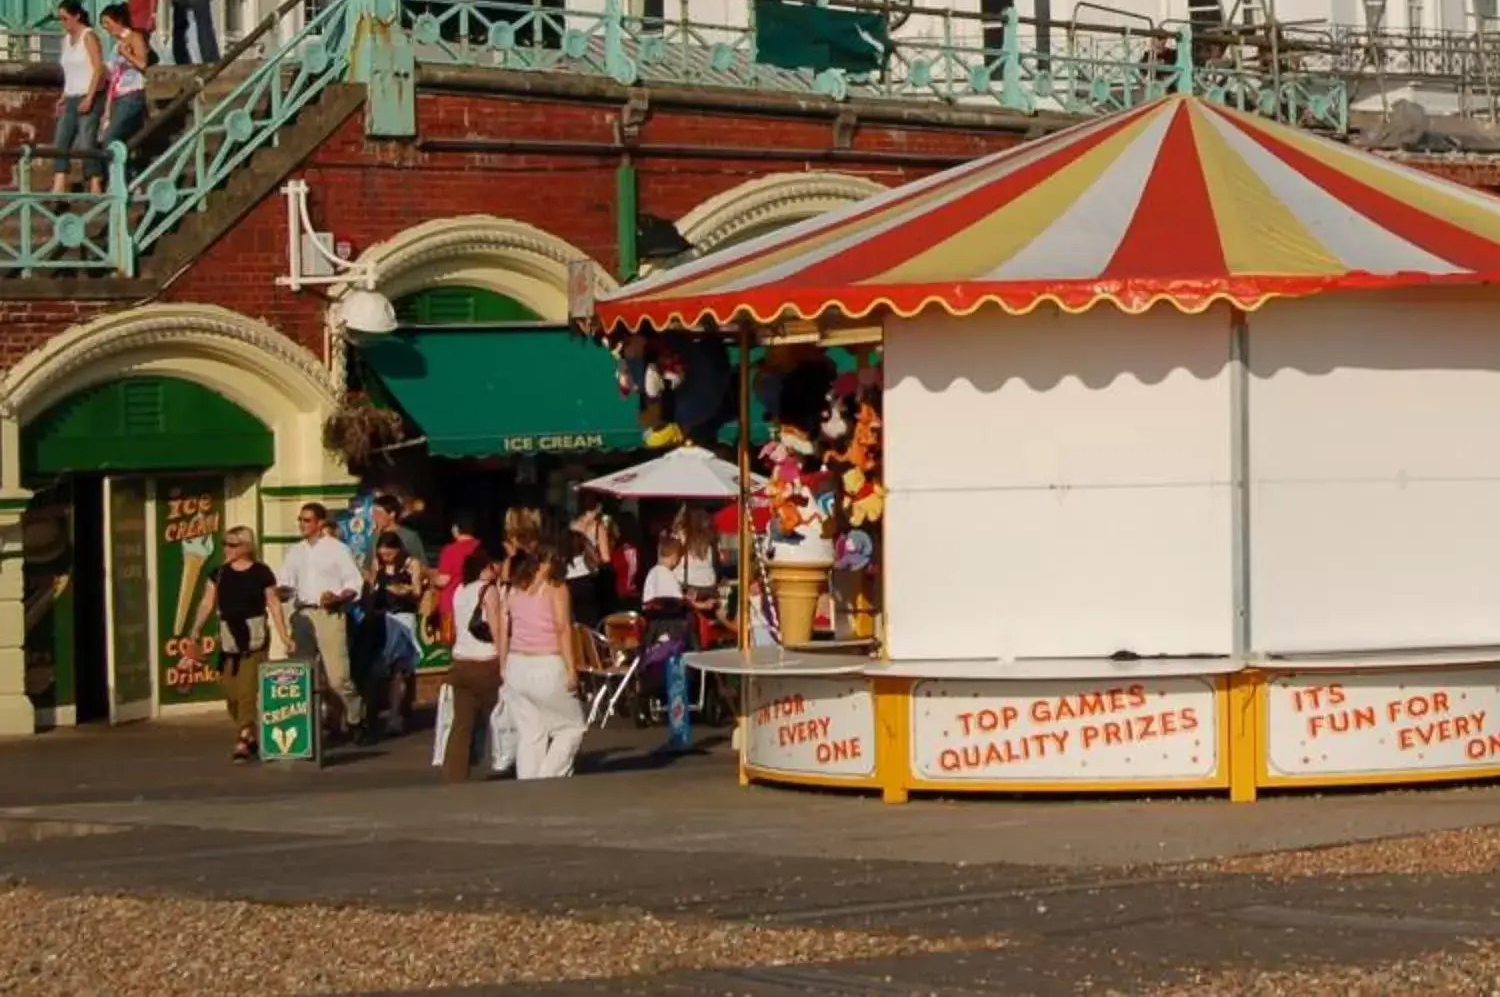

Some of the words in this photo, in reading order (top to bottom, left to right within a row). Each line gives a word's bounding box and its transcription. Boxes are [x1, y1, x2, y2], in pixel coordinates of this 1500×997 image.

[503, 436, 533, 452] ICE
[540, 434, 603, 450] CREAM
[164, 511, 220, 542] CREAM
[165, 636, 215, 656] COD
[166, 664, 222, 686] Drink
[271, 684, 301, 700] ICE
[1293, 683, 1346, 712] ITS
[262, 701, 307, 725] CREAM
[774, 693, 805, 721] FOR
[957, 706, 1019, 737] TOP
[1031, 684, 1148, 723] GAMES
[1309, 706, 1377, 739] FUN
[1387, 691, 1450, 724] FOR
[779, 716, 832, 747] EVERY
[938, 730, 1070, 772] QUALITY
[1081, 707, 1200, 749] PRIZES
[1398, 711, 1487, 751] EVERY
[816, 737, 862, 765] ONE
